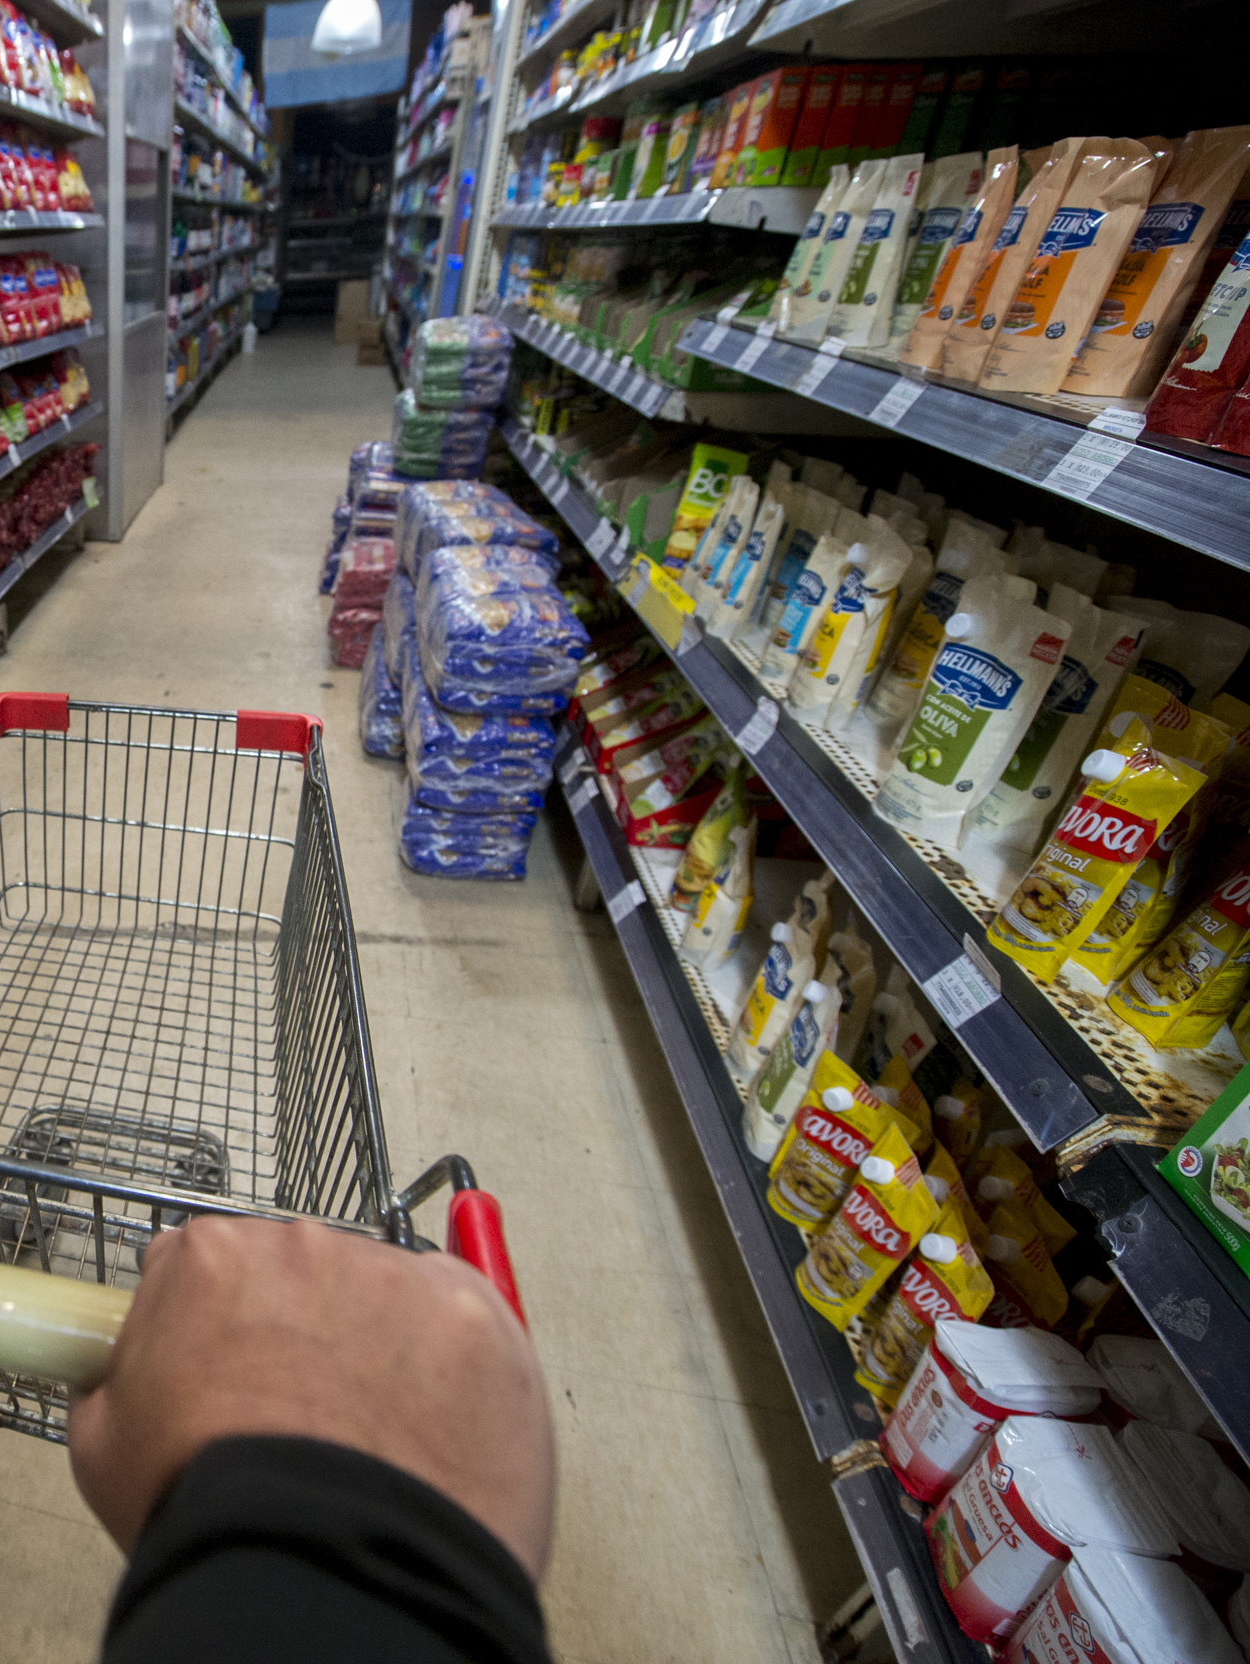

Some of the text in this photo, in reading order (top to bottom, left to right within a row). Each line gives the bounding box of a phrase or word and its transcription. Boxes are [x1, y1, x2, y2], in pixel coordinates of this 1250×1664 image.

[937, 649, 1013, 698] HELLMANN'S
[919, 705, 959, 738] OLIVA
[925, 693, 972, 724] CON ACEITE DE
[1045, 842, 1092, 873] riginal
[796, 1138, 846, 1177] Original
[1223, 1232, 1241, 1252] 500g
[968, 1493, 994, 1543] Gruesa
[1036, 1619, 1052, 1646] Sal
